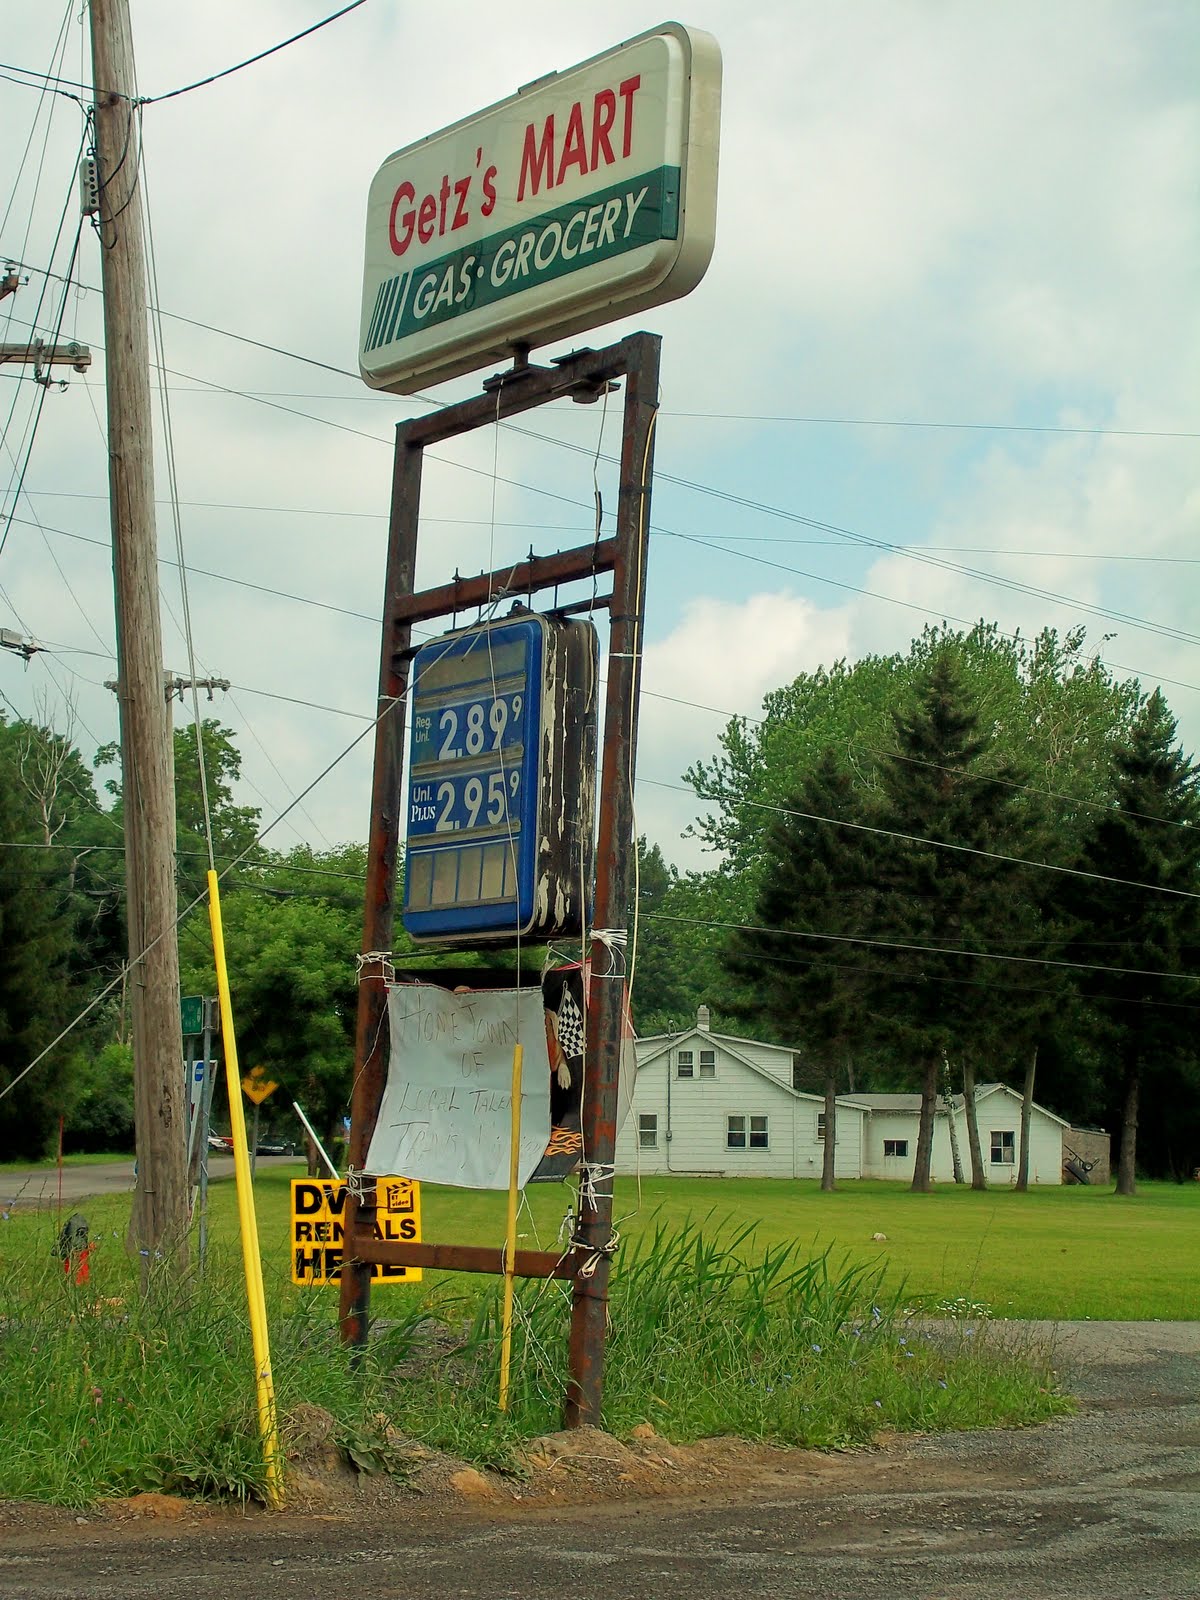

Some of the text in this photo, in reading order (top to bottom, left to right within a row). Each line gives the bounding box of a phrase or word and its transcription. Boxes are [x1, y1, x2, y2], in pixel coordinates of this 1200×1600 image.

[389, 74, 641, 257] Getz's MART
[490, 187, 648, 287] GROCERY
[411, 804, 436, 822] PLUS
[461, 1052, 485, 1078] OF
[296, 1184, 347, 1214] DV
[296, 1219, 416, 1242] RENALS
[296, 1248, 406, 1279] HE
